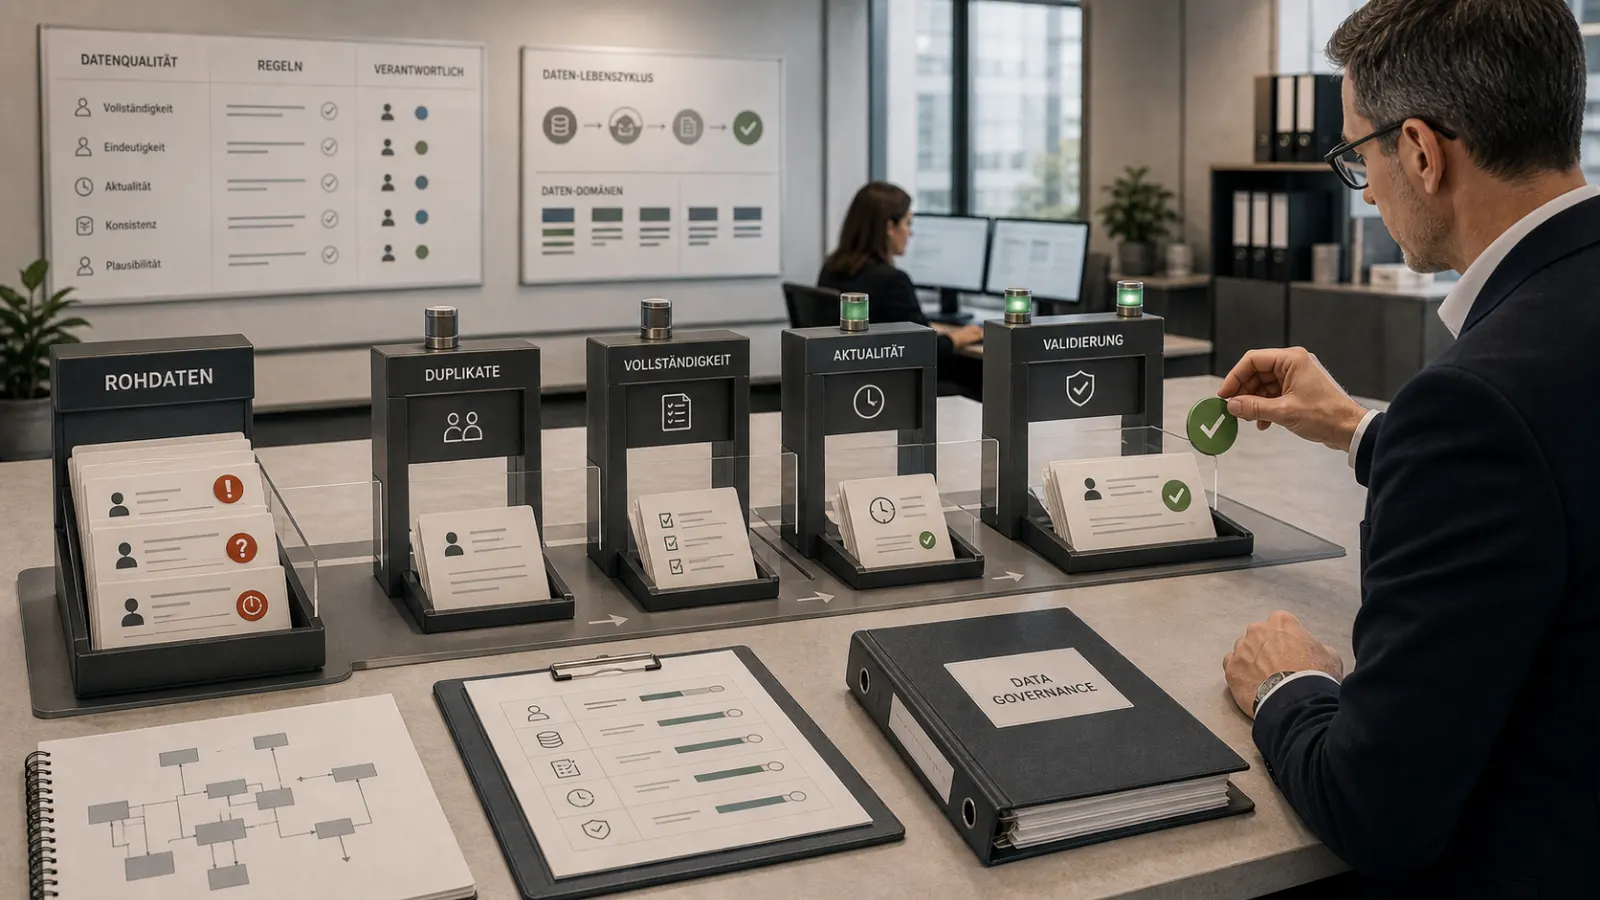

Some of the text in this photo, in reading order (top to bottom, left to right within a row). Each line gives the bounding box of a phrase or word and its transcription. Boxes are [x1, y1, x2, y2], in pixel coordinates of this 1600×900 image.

[81, 53, 178, 69] DATENQUALITÄT
[258, 60, 302, 73] REGELN
[374, 63, 464, 77] VERANTWORTLICH
[543, 69, 654, 83] DATEN-LEBENSZYKLUS
[103, 102, 174, 116] Vollständigkeit
[104, 142, 166, 155] Eindeutigkeit
[105, 181, 152, 192] Aktualität
[541, 184, 623, 197] DATEN-DOMÄNEN
[106, 219, 157, 231] Konsistenz
[106, 259, 162, 271] Plausibilität
[1043, 333, 1124, 351] VALIDIERUNG
[834, 344, 905, 362] AKTUALITÄT
[624, 353, 732, 371] VOLLSTÄNDIGKEIT
[105, 368, 213, 391] ROHDATEN
[425, 365, 500, 381] DUPLIKATE
[1010, 674, 1053, 688] DATA
[993, 682, 1098, 705] GOVERNANCE
